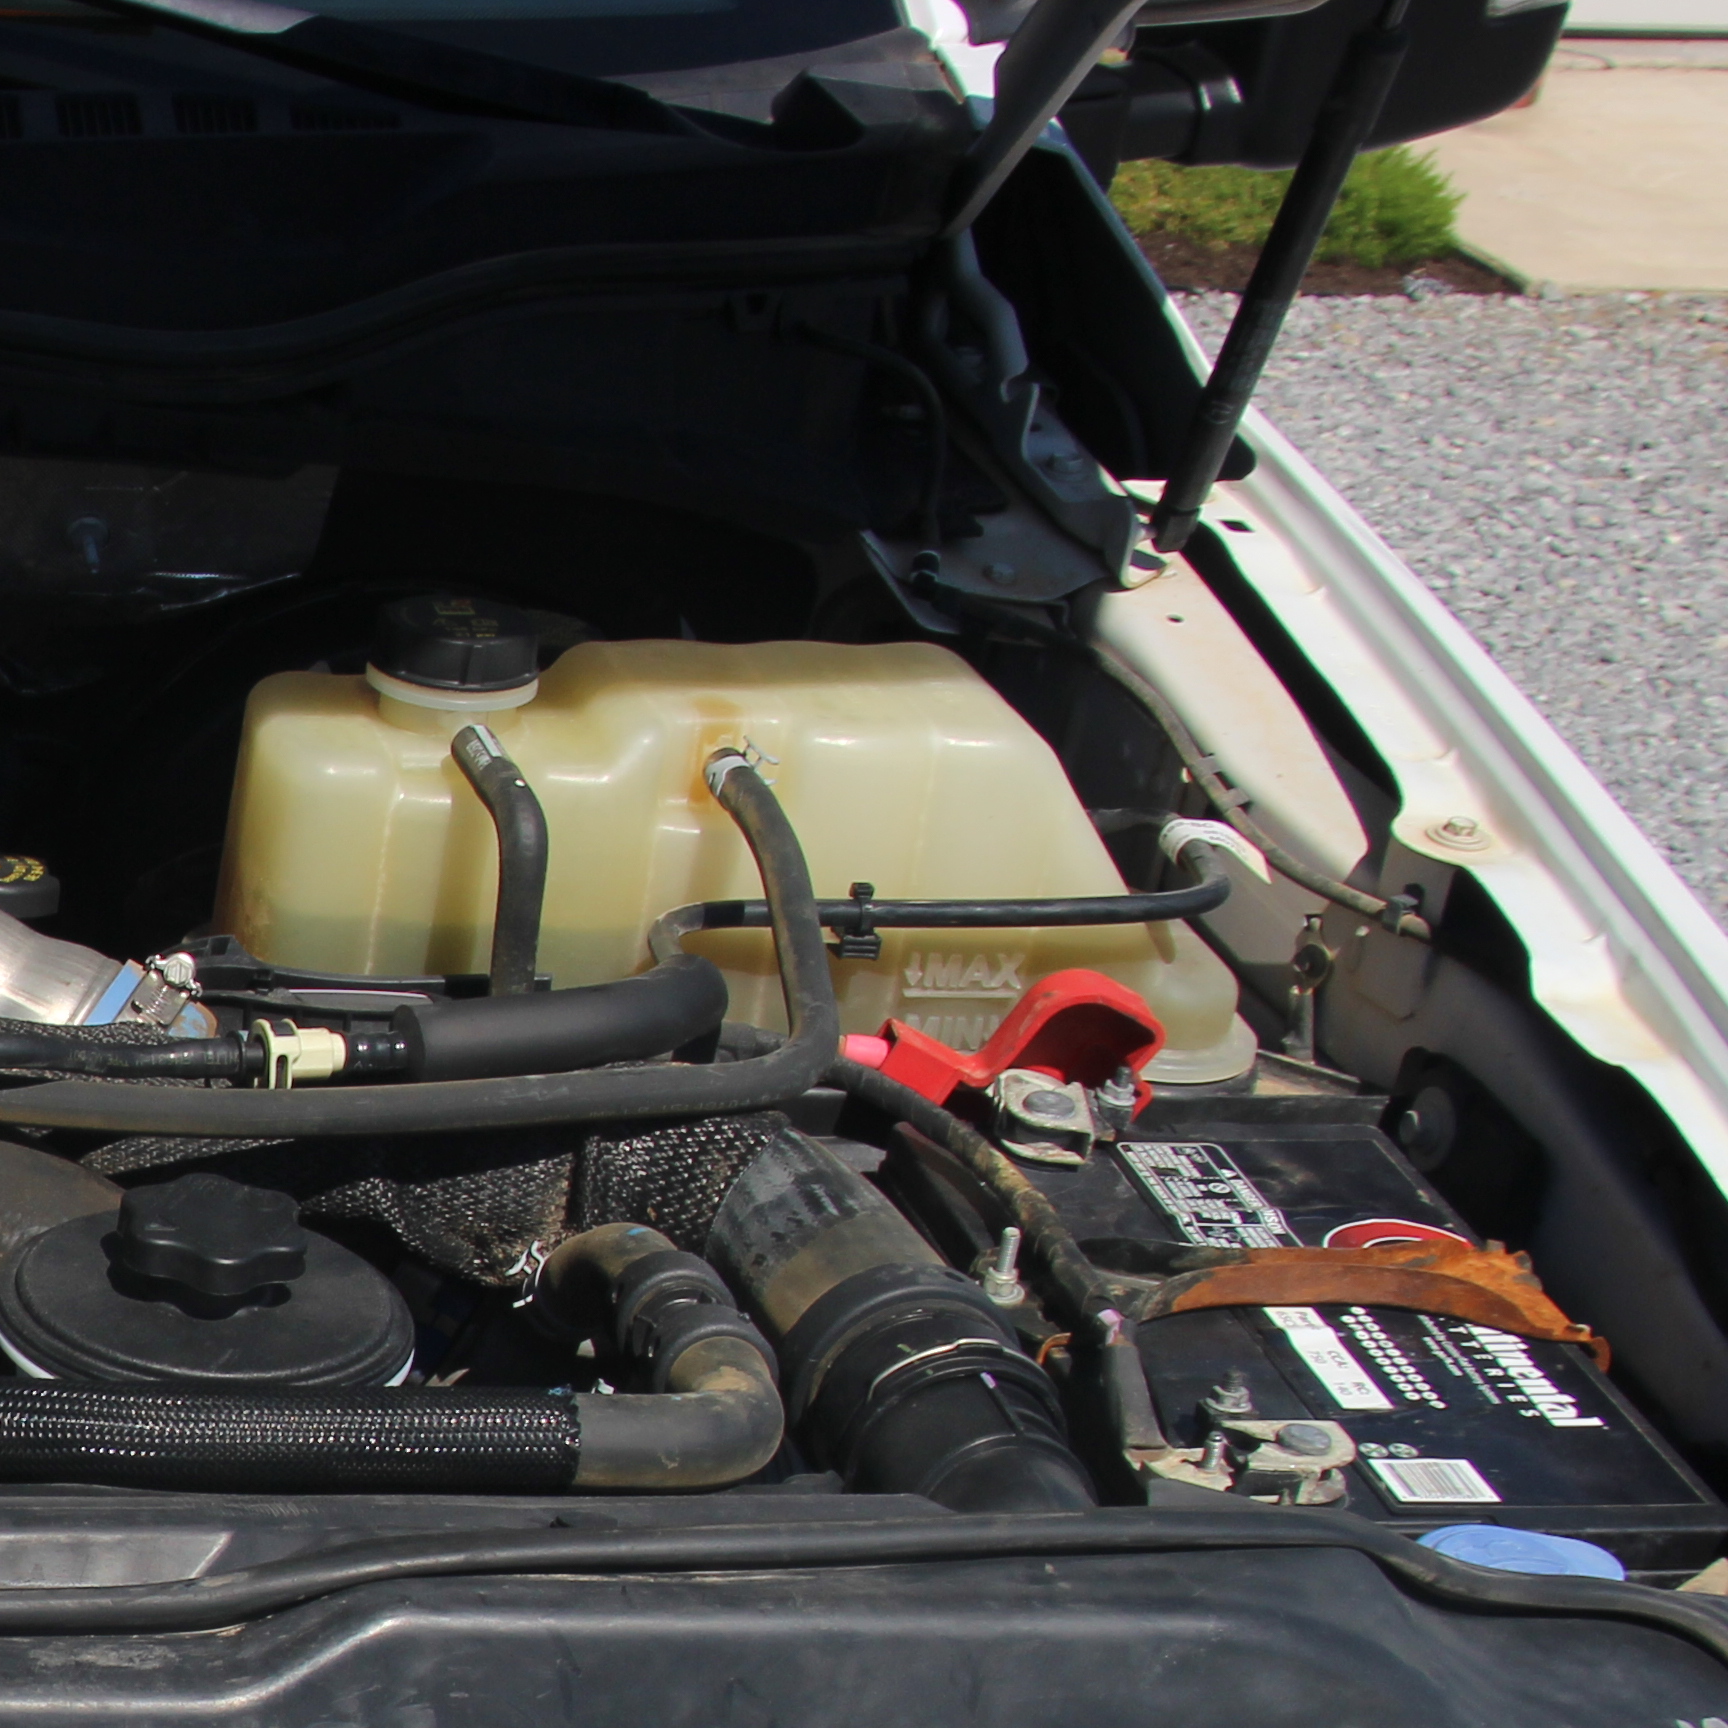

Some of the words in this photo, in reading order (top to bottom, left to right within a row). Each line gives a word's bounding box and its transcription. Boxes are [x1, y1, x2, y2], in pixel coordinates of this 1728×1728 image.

[923, 952, 1025, 989] MAX
[1448, 1326, 1541, 1418] TTERIES
[1467, 1326, 1605, 1427] tinental
